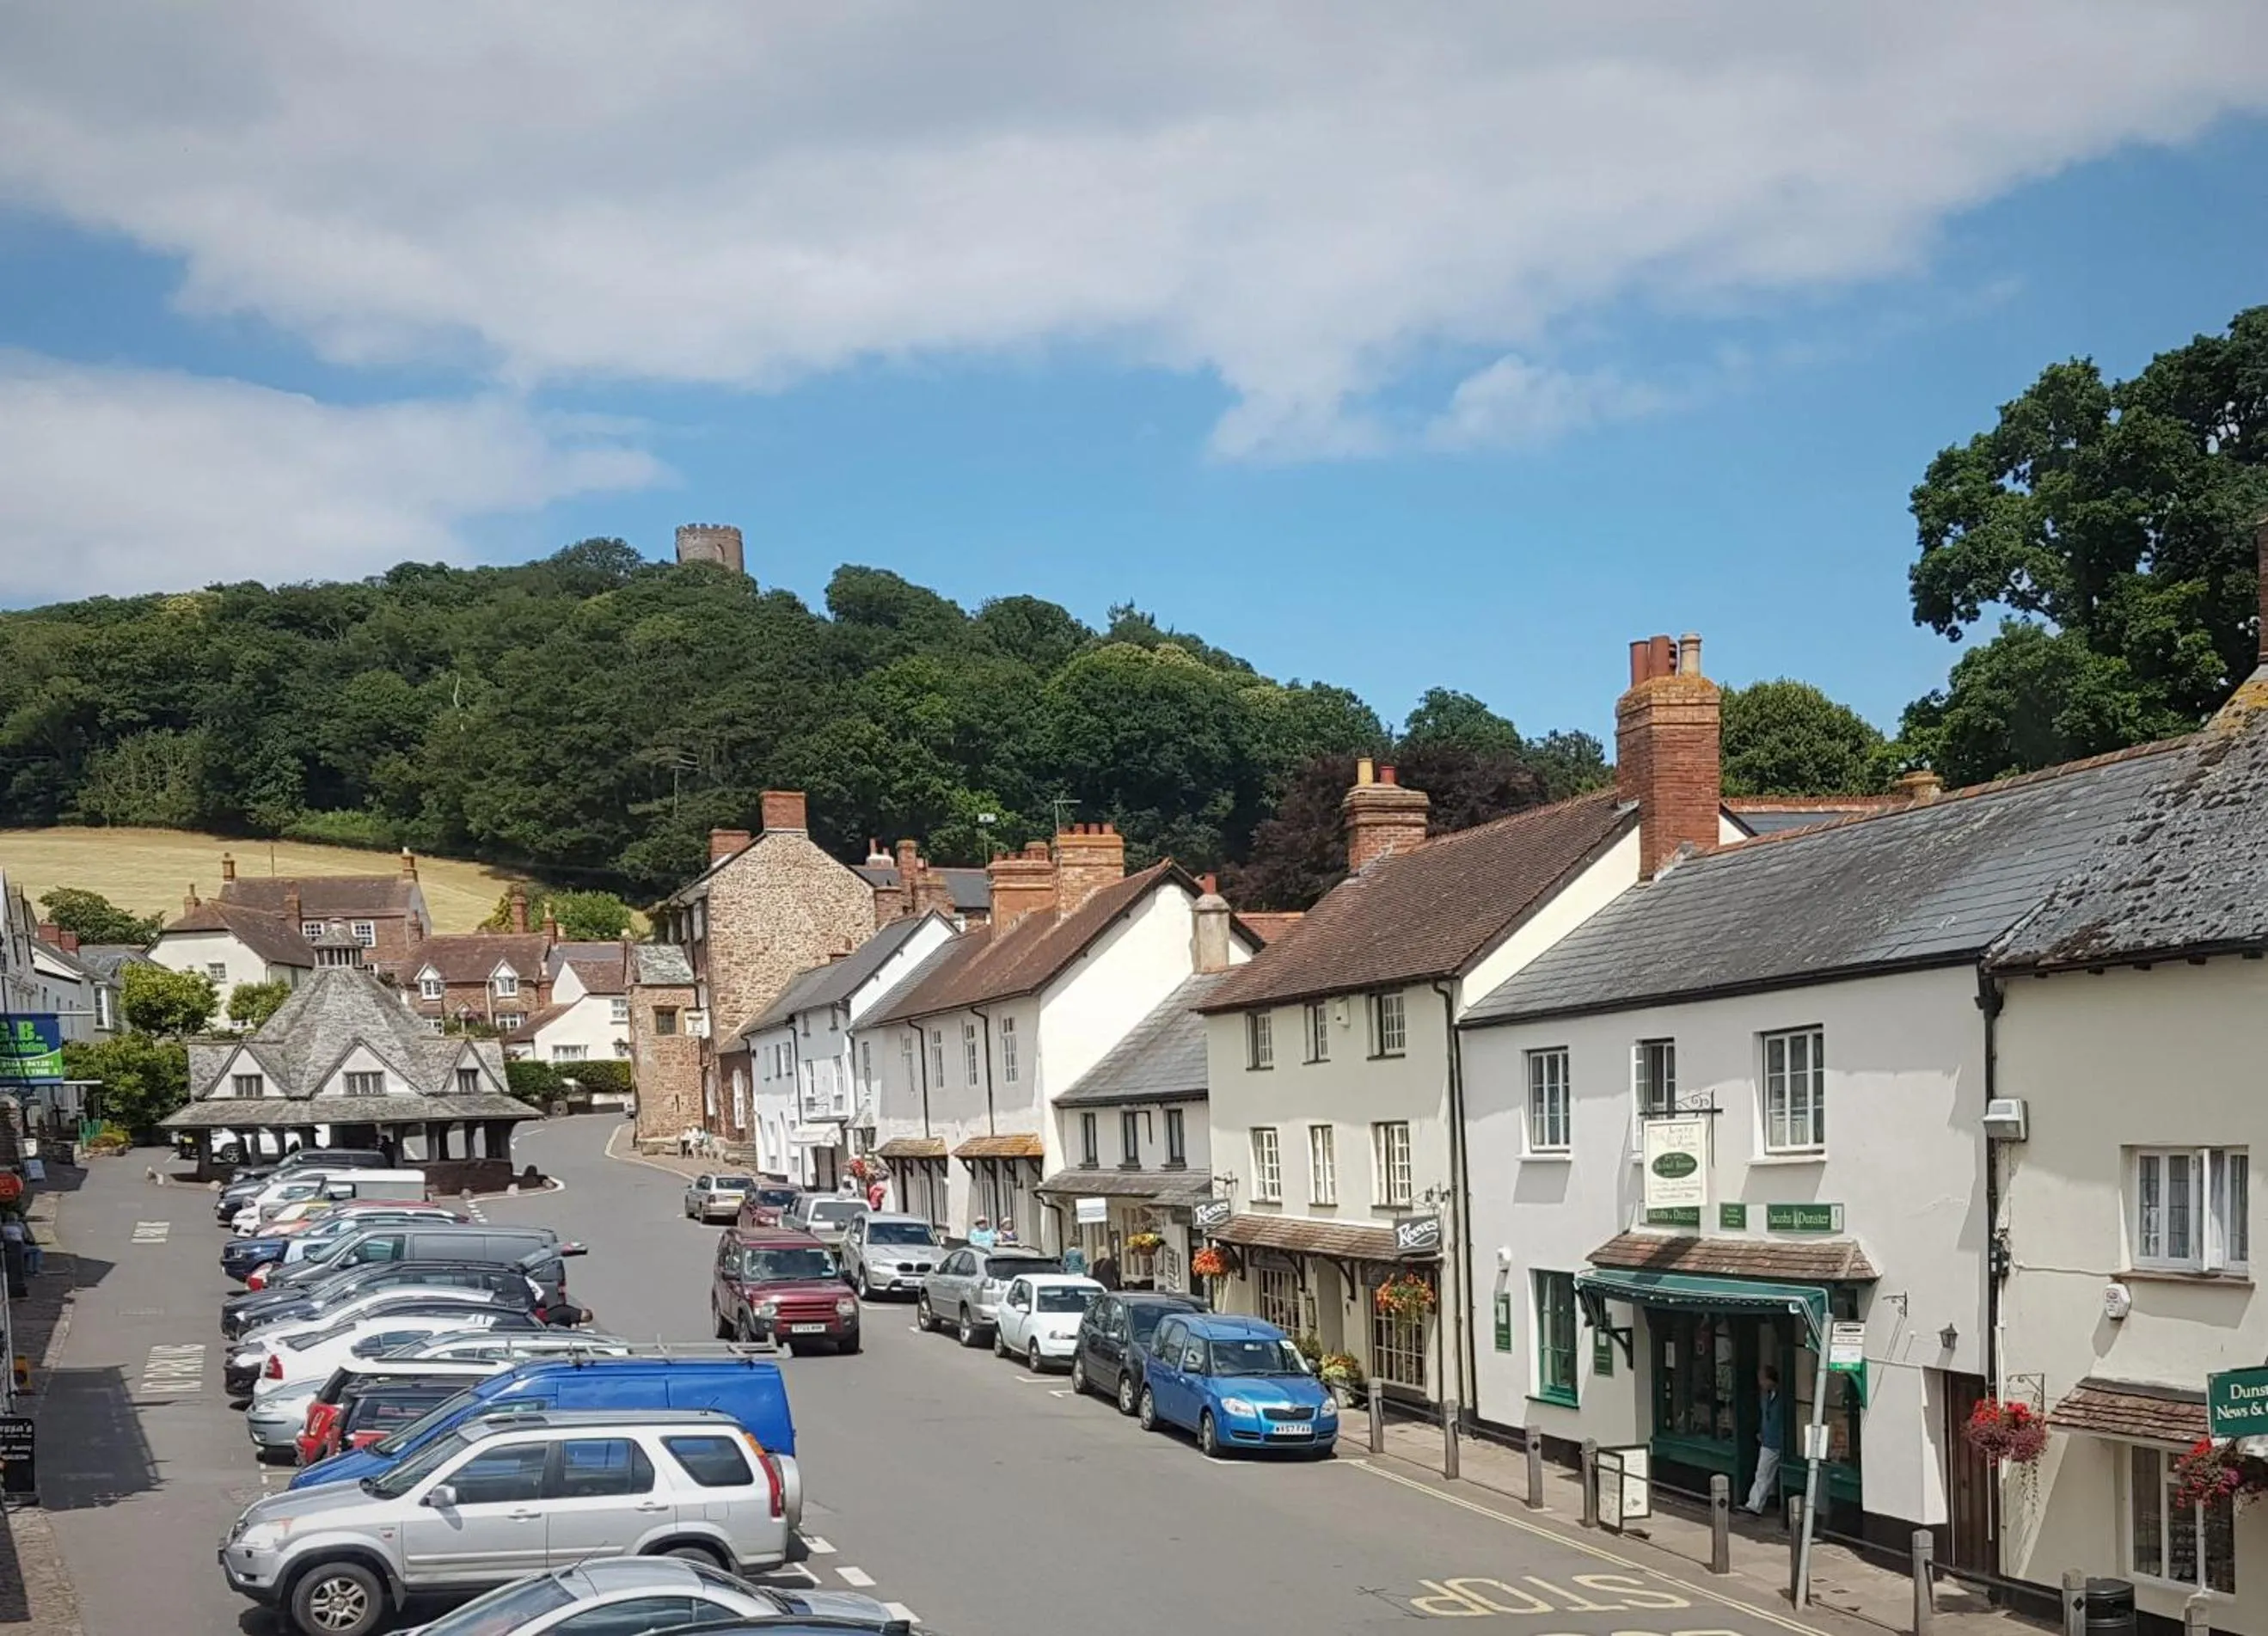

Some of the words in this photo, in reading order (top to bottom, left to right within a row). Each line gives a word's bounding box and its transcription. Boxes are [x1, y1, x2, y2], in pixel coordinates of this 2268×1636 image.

[1195, 1202, 1229, 1225] Reeves
[1799, 1210, 1829, 1225] Dunster
[1397, 1219, 1438, 1248] Reeves
[2216, 1404, 2248, 1420] News
[2250, 1401, 2265, 1416] &
[1410, 1574, 1691, 1617] STOP
